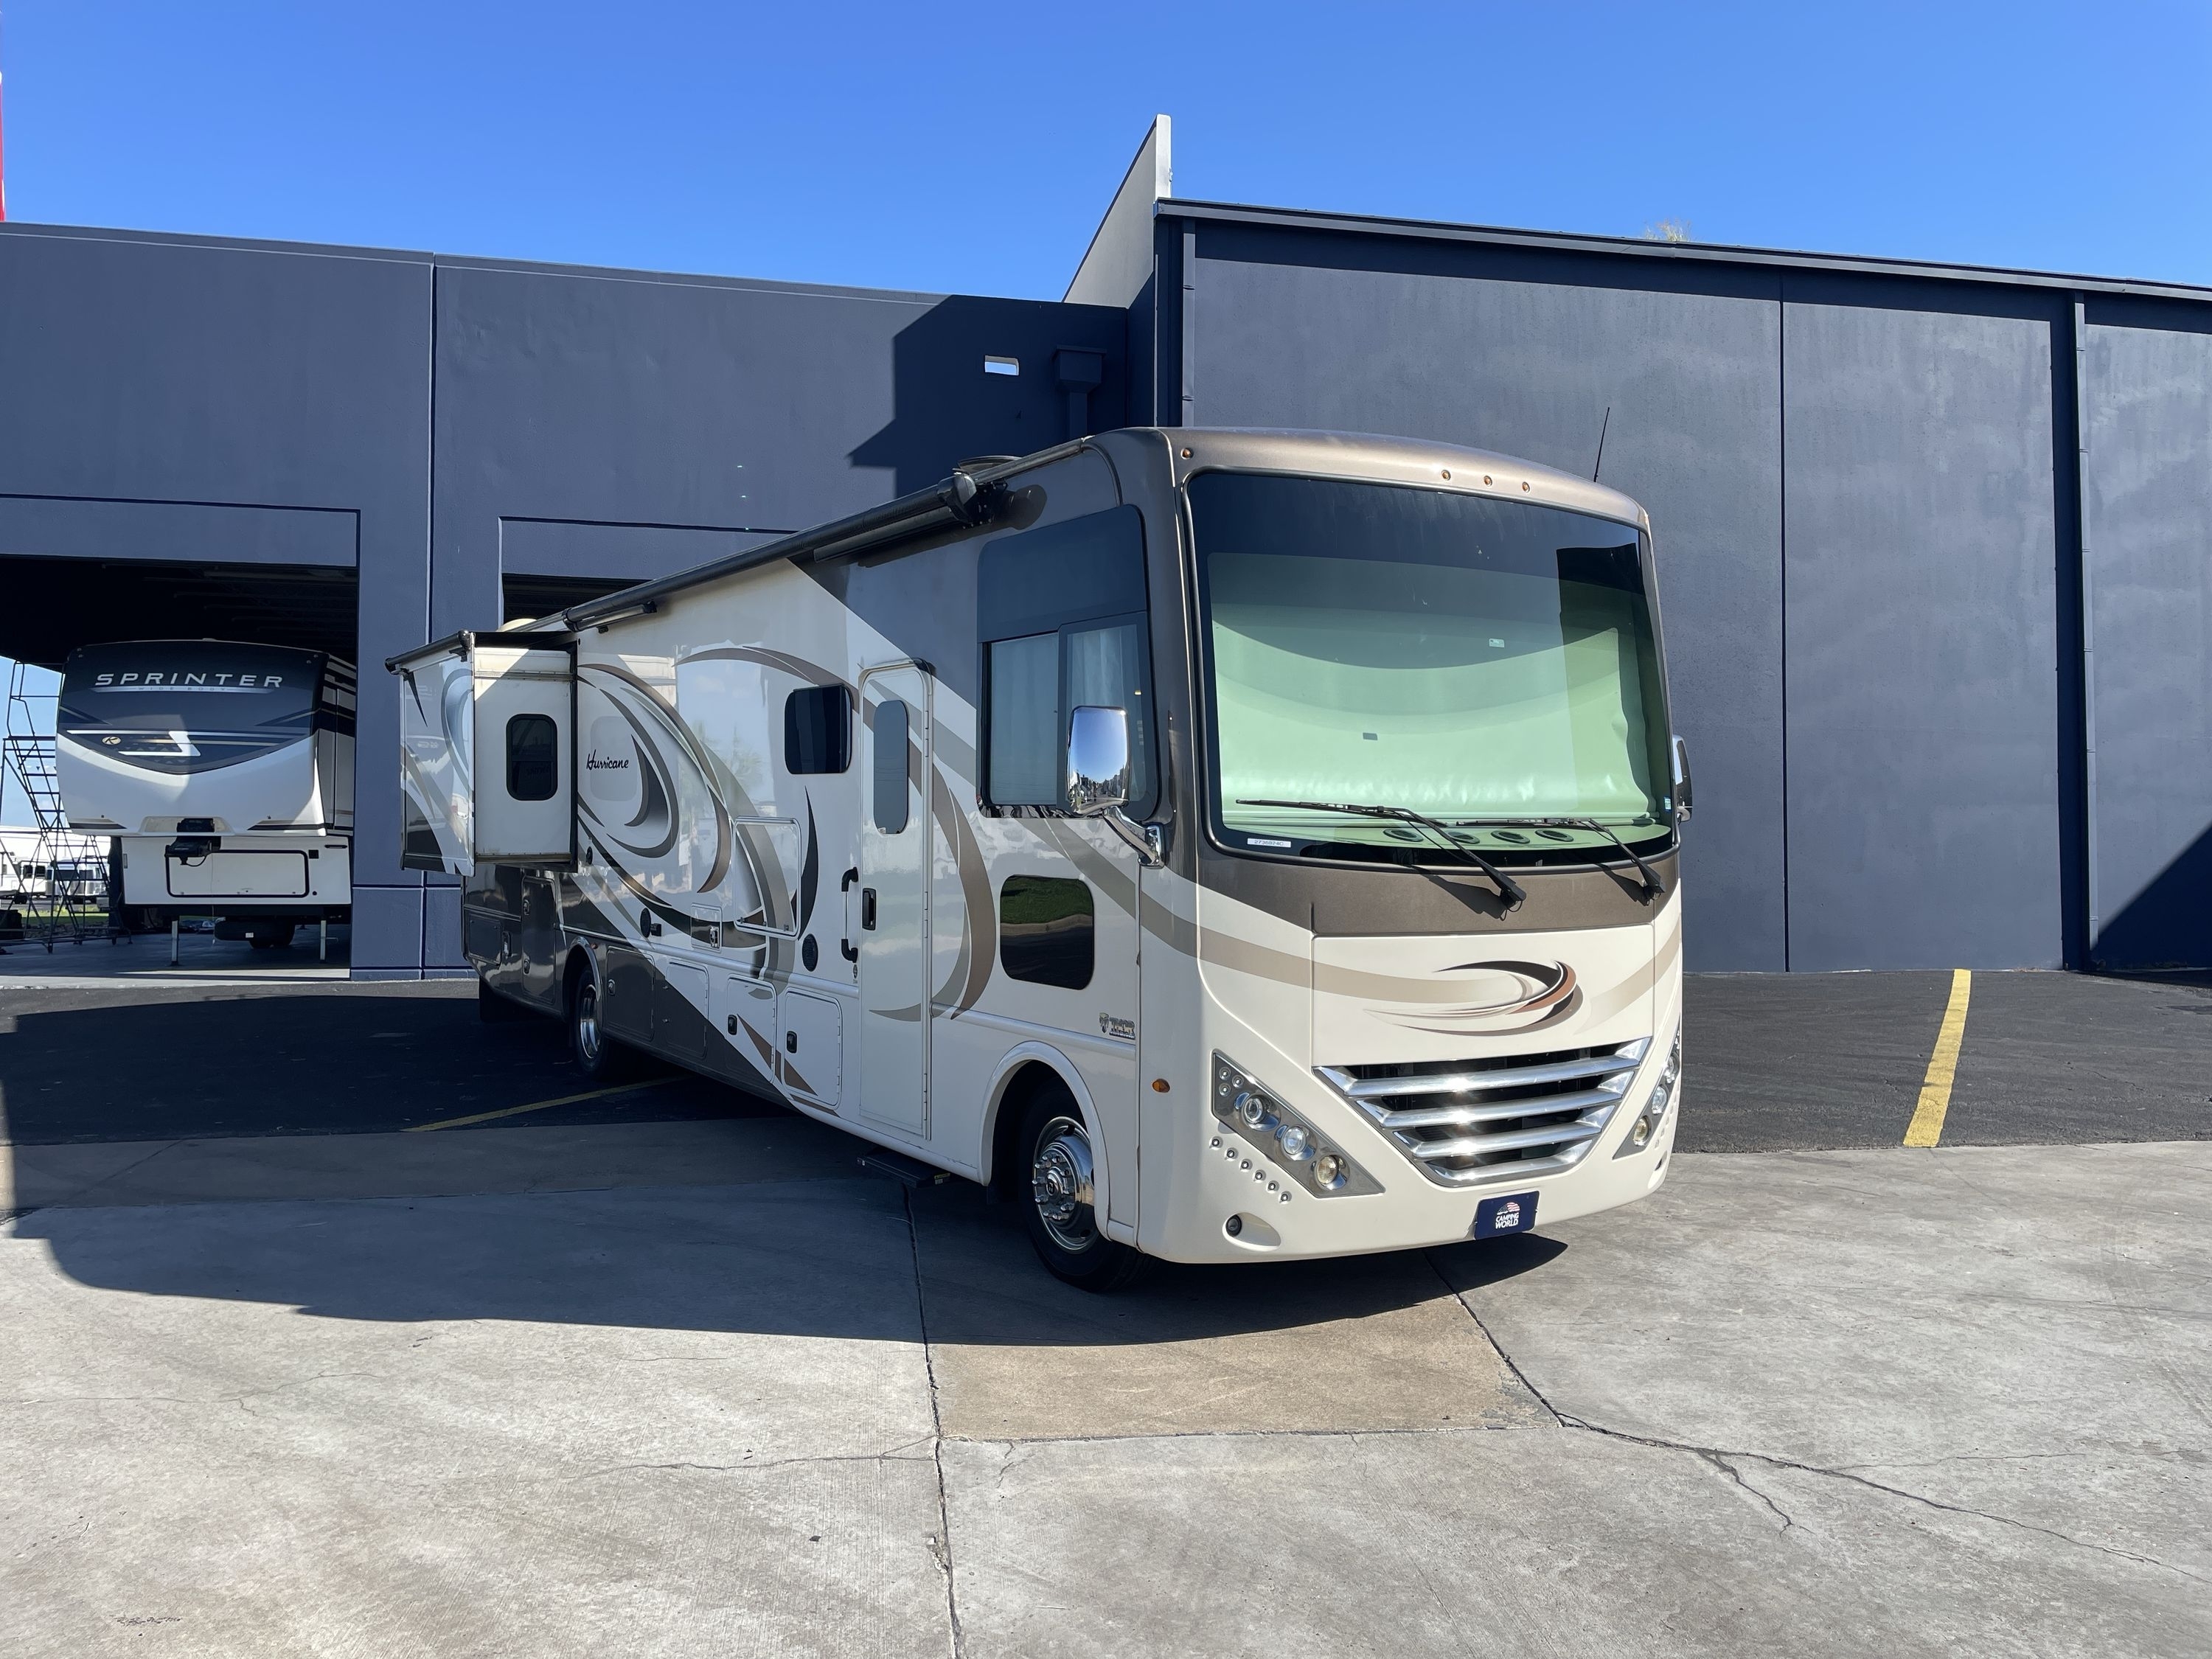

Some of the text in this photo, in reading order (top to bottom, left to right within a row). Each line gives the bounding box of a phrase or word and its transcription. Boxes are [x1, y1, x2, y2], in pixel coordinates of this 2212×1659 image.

[94, 672, 283, 688] SPRINTER
[586, 749, 629, 771] Hurricane
[1495, 1212, 1519, 1222] CAMPING
[1495, 1218, 1519, 1229] WORLD
